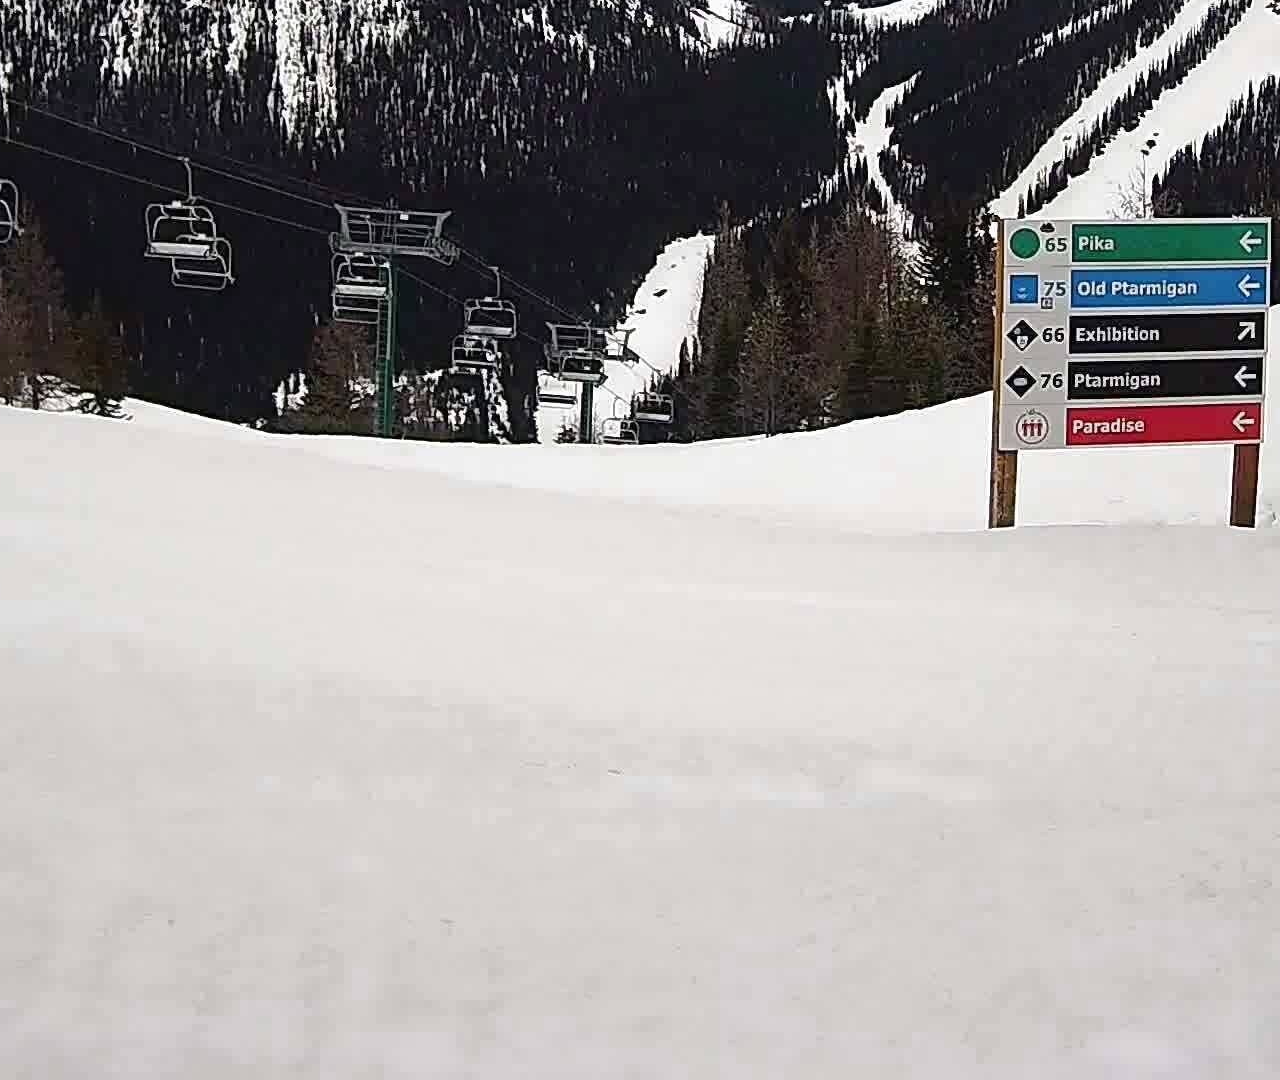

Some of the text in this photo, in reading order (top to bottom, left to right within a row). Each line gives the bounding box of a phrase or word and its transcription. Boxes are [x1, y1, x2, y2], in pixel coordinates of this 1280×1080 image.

[1045, 236, 1115, 252] 65 Pika
[1043, 280, 1198, 298] 75 Old Ptarmigan
[1042, 326, 1160, 342] 66 Exhibition
[1040, 372, 1161, 390] 76 Ptarmigan
[1072, 417, 1145, 434] Paradise
